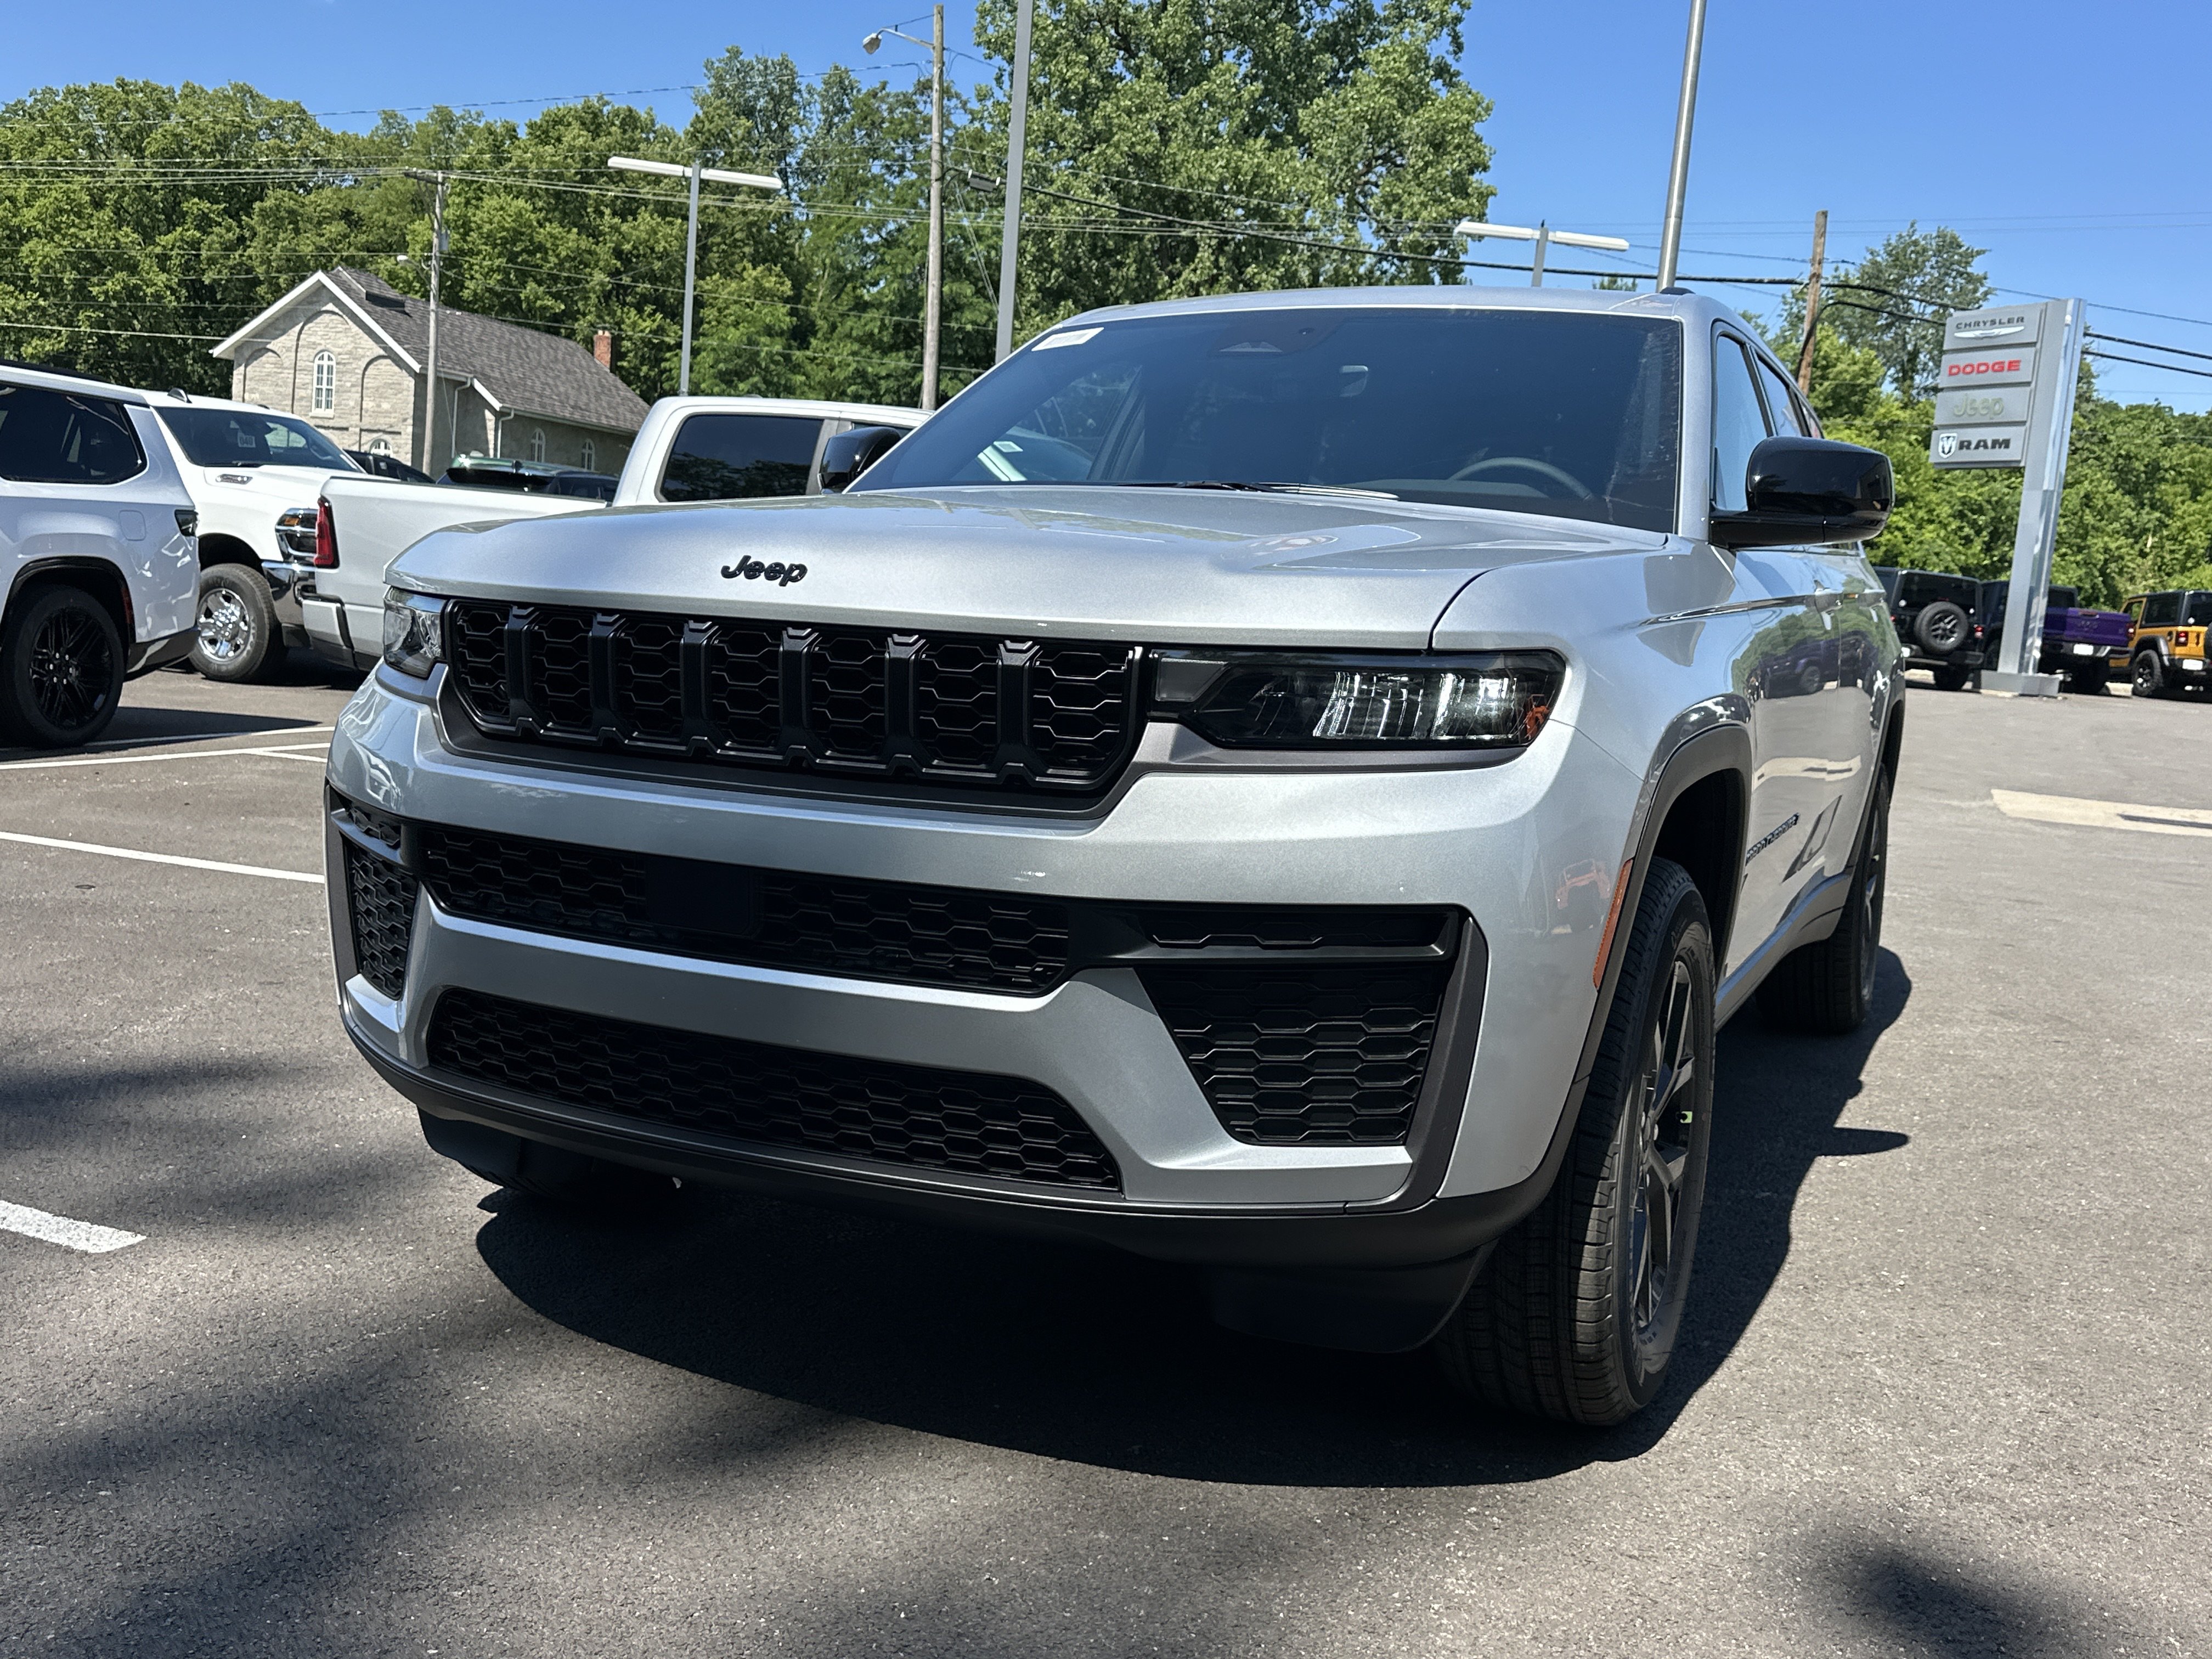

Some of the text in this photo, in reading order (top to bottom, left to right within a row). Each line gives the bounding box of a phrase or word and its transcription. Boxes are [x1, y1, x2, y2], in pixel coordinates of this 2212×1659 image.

[1956, 316, 2025, 329] CHRYSLER
[1948, 359, 2022, 377] DODGE
[1953, 394, 2004, 420] Jeep
[1959, 438, 2011, 450] RAM
[720, 555, 808, 587] Jeep
